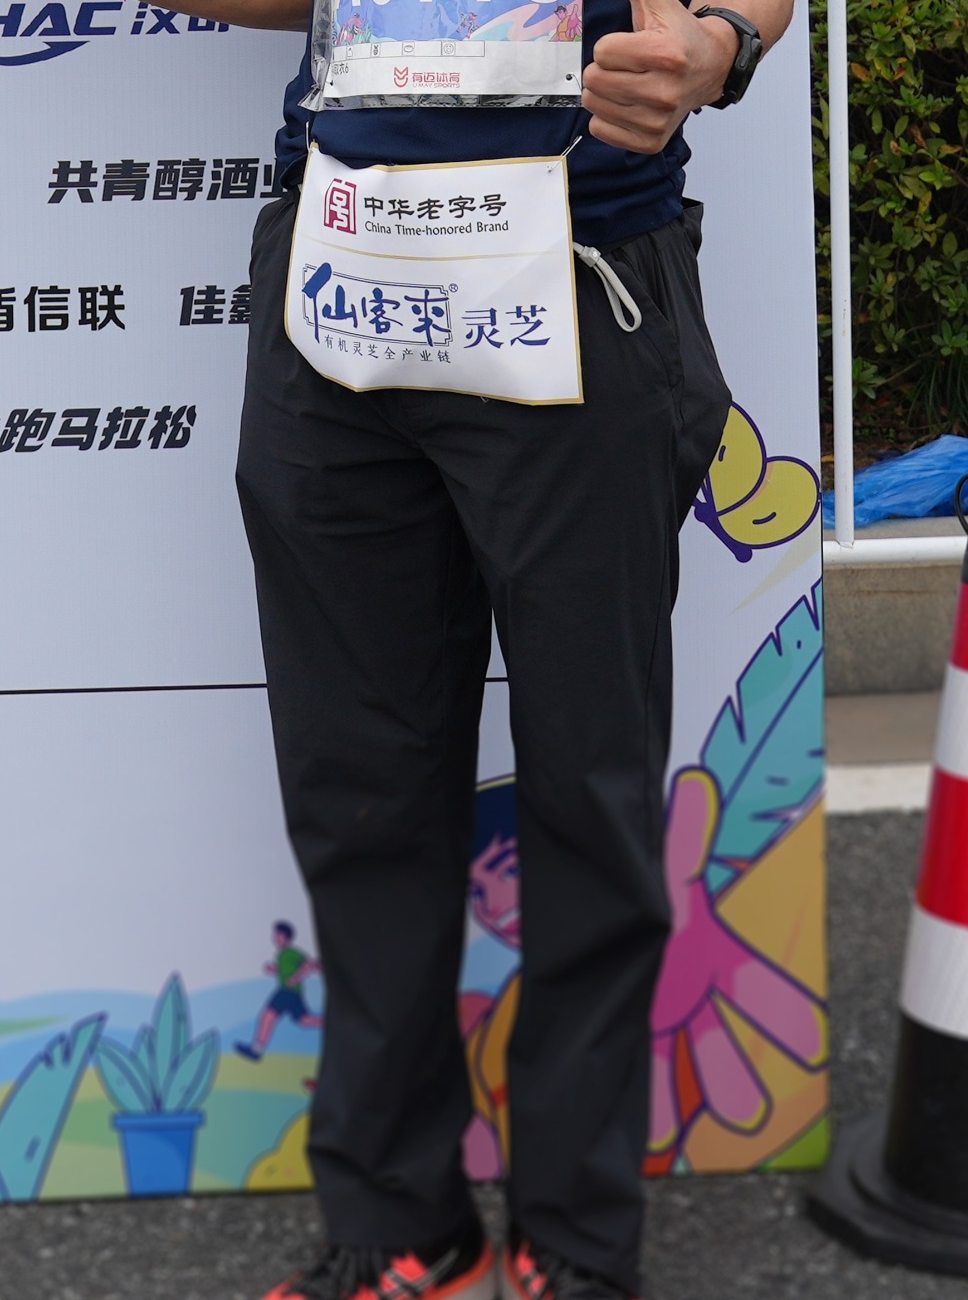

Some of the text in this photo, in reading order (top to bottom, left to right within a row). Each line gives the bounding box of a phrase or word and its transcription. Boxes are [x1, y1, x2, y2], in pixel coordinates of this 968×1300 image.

[412, 72, 461, 84] 有迈体育
[363, 193, 507, 220] 中华老字号
[364, 220, 509, 236] China Time-honored Brand
[461, 305, 551, 348] 灵芝
[324, 334, 452, 364] 有机灵芝全产业链
